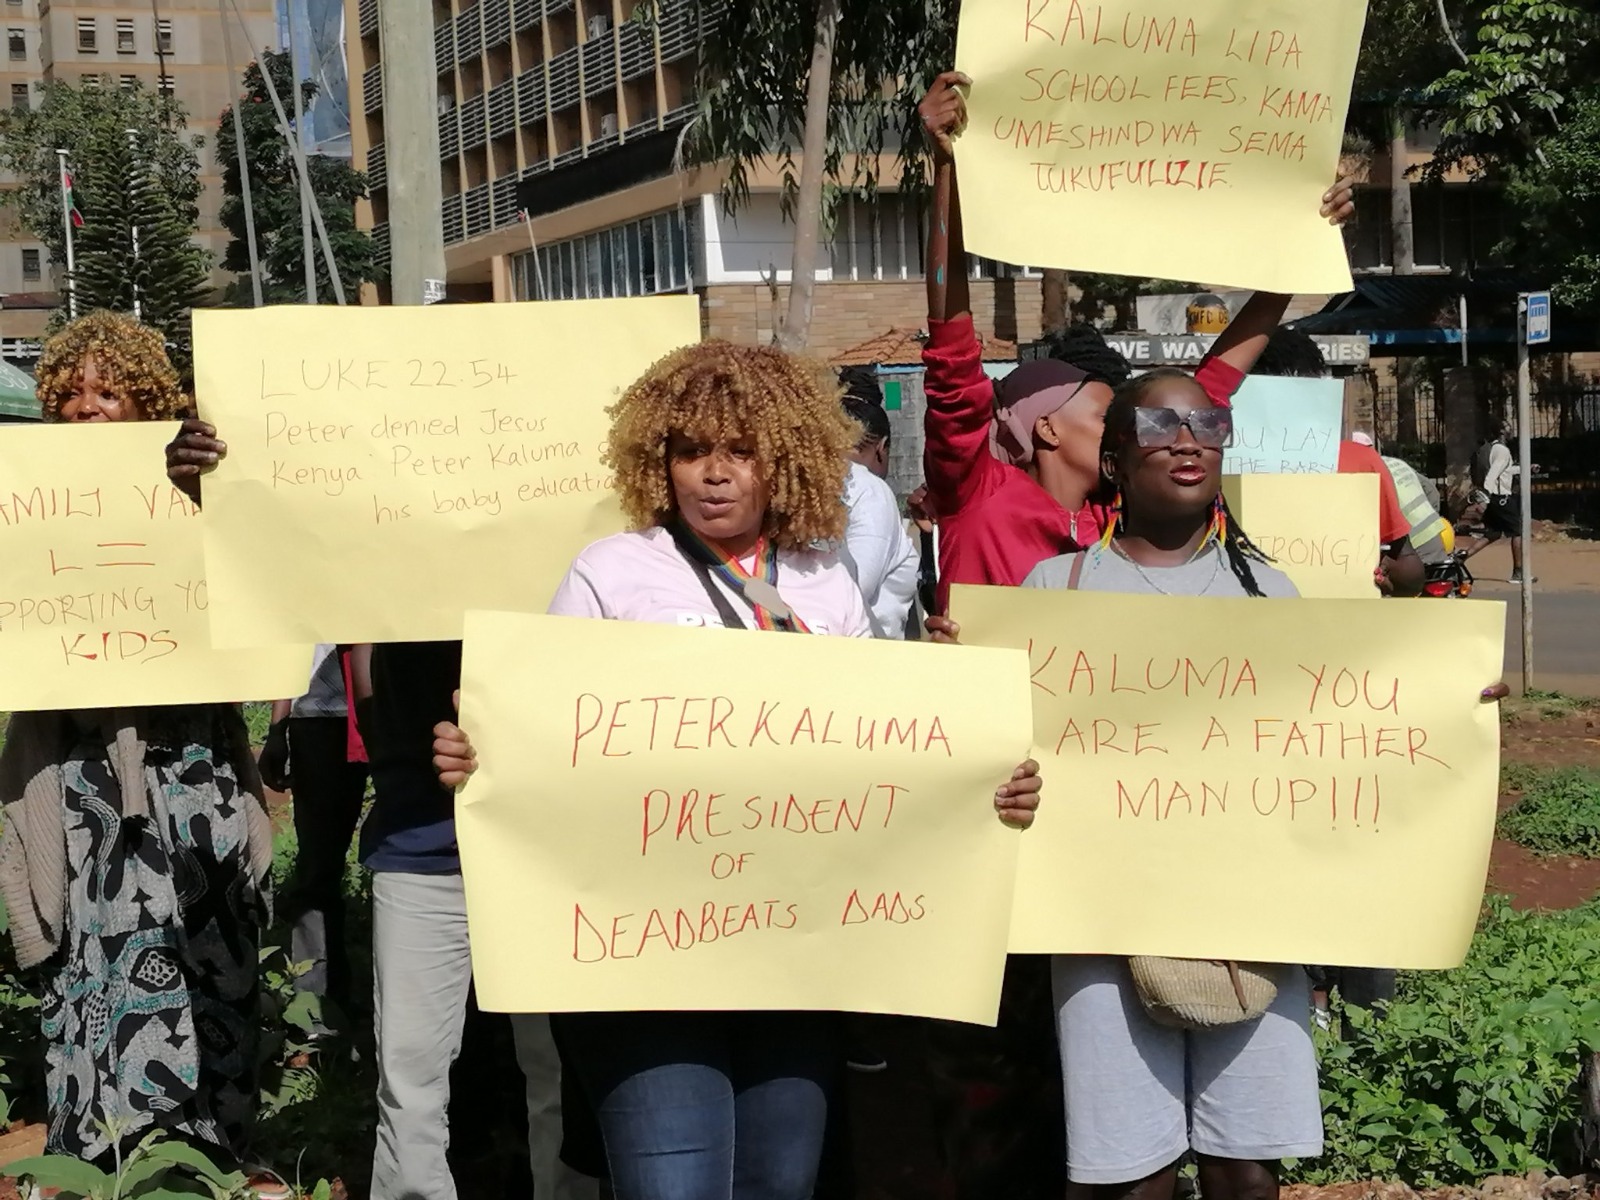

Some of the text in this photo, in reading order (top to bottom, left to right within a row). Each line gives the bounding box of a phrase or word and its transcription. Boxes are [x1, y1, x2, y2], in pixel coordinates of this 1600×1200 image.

[1025, 0, 1304, 70] KALUMA LIPA
[1020, 67, 1334, 124] SCHOOL FEES, KAMA
[994, 115, 1309, 162] UMESHINDWA SEMA
[260, 358, 388, 400] LUKE
[265, 407, 548, 448] Peter denied Jesus
[1281, 426, 1333, 452] LAY
[391, 444, 472, 476] Peter
[487, 440, 582, 471] Kaluma
[1222, 455, 1271, 473] THE
[373, 493, 412, 526] his
[433, 487, 502, 516] baby
[49, 548, 84, 577] L
[60, 629, 178, 666] KIDS
[1029, 638, 1400, 715] KALUMA YOU
[1056, 716, 1452, 770] ARE A FATHER
[641, 783, 911, 856] PRESIDENT
[1116, 774, 1381, 834] MAN UP!!!
[710, 851, 756, 880] OF
[572, 900, 799, 964] DEADBEATS
